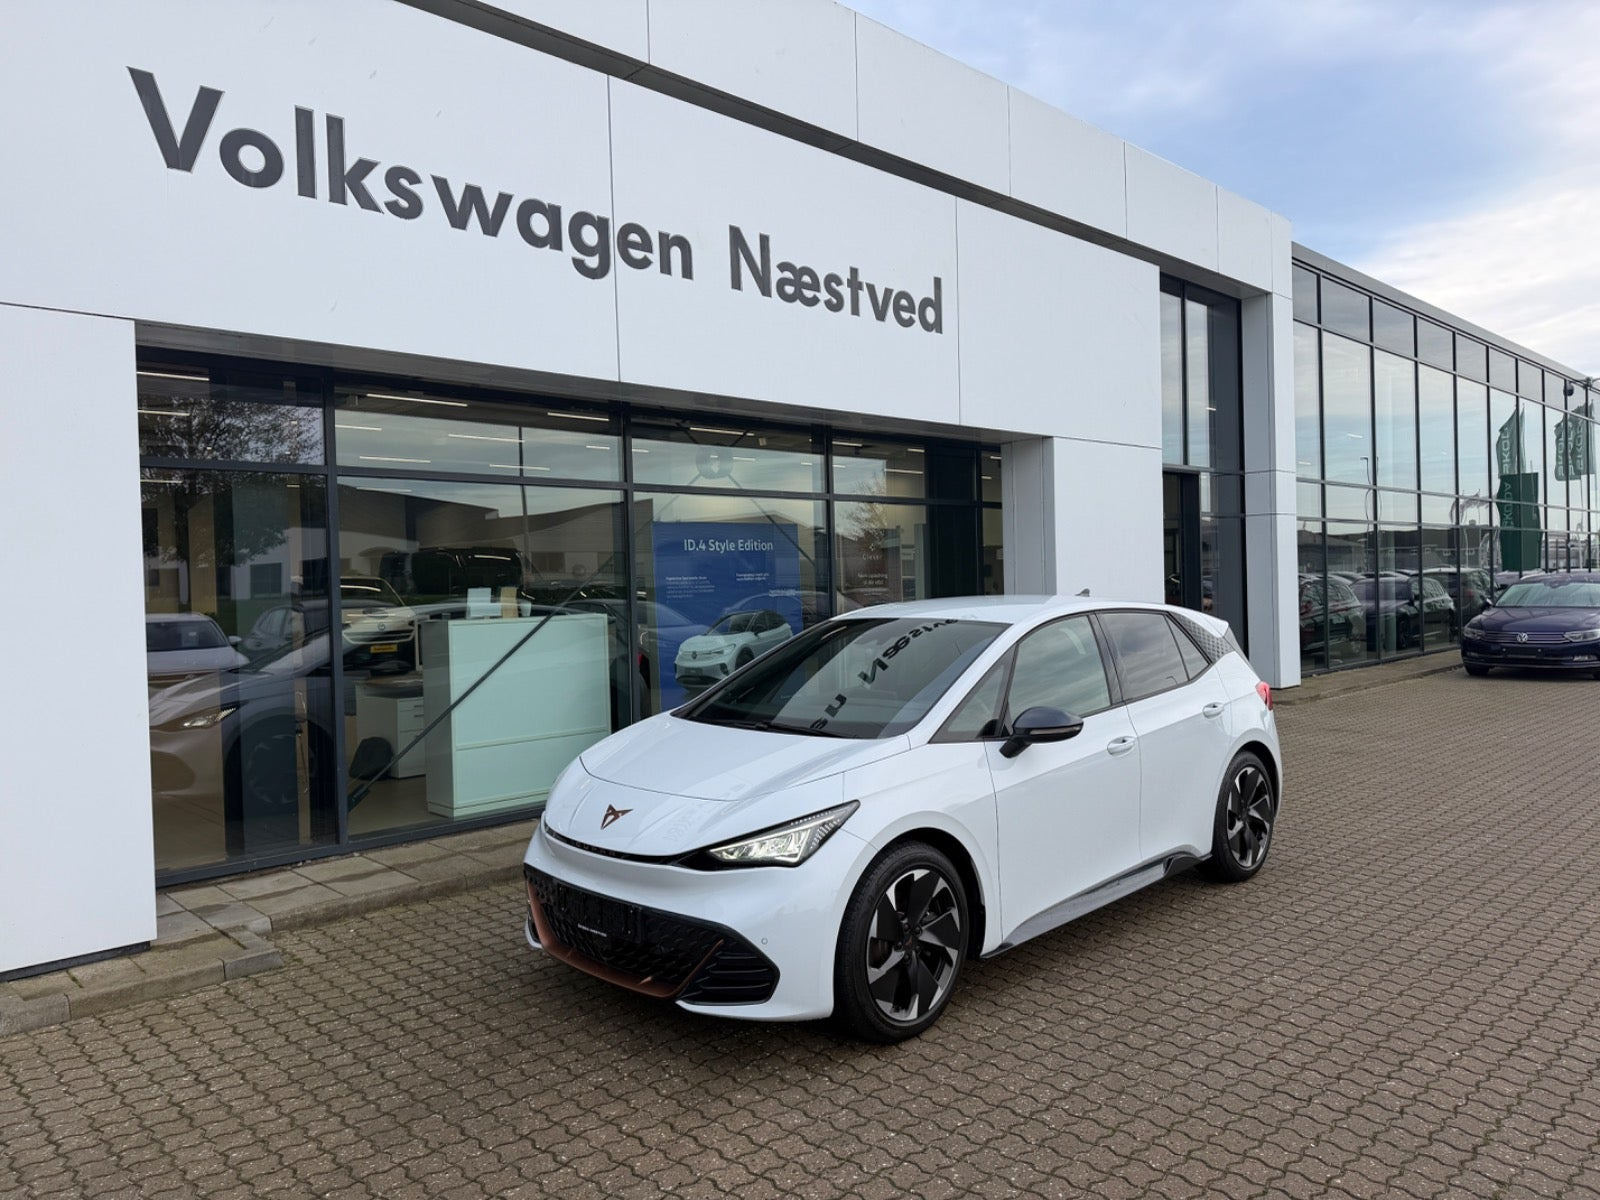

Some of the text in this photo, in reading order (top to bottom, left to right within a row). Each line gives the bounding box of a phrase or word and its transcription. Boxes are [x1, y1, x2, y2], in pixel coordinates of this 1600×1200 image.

[126, 66, 943, 335] Volkswagen Næstved
[684, 539, 773, 553] ID.4 Style Edition
